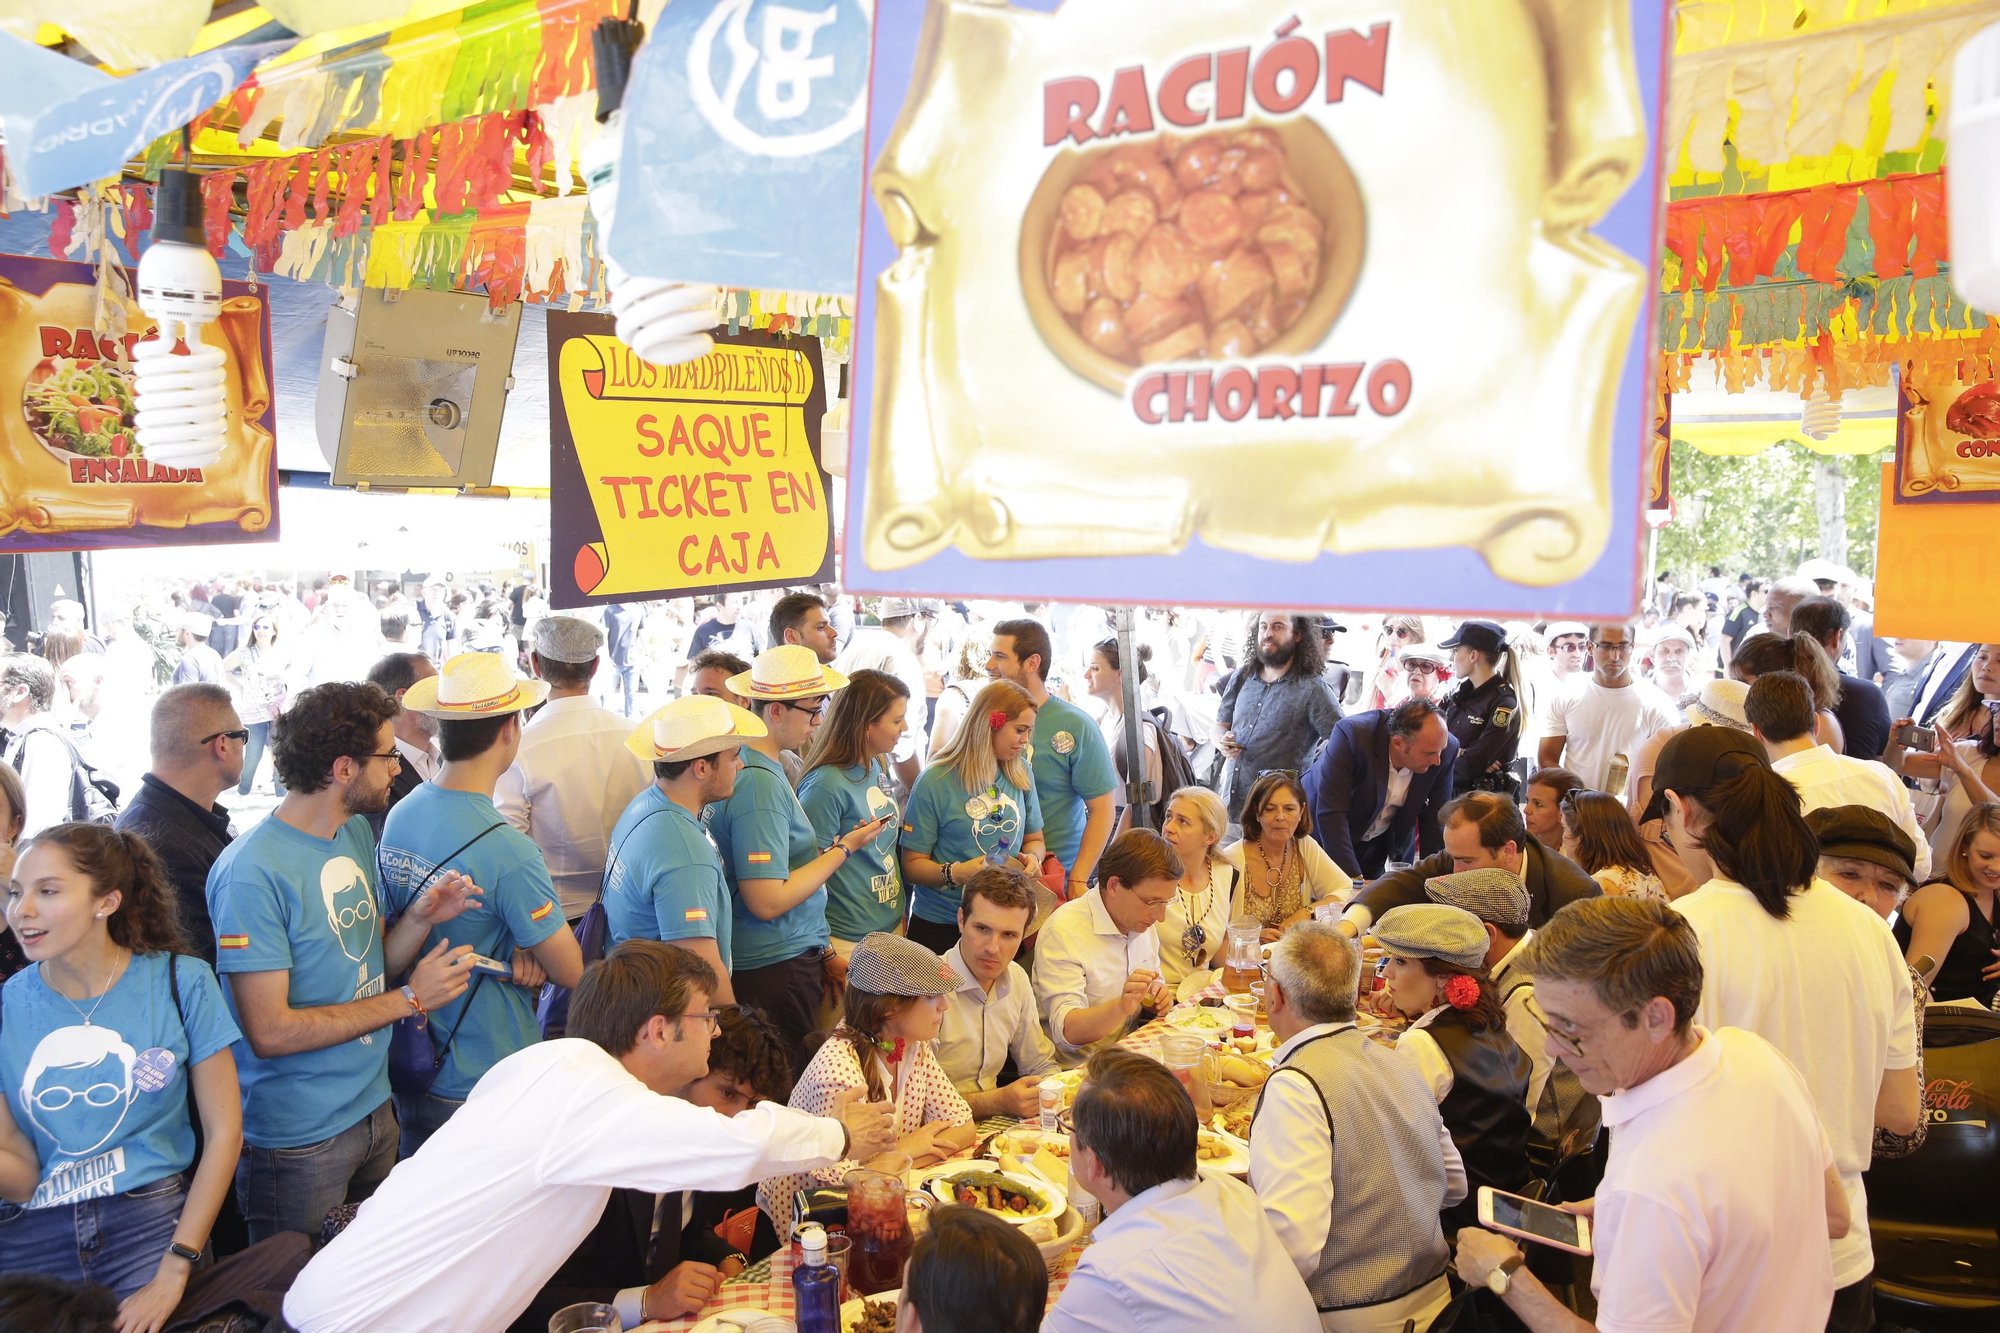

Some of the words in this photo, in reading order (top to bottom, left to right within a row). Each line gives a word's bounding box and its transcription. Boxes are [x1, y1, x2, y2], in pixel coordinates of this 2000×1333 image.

[1044, 14, 1391, 147] RACIÓN
[662, 348, 792, 394] MADRILEÑOS
[1132, 358, 1412, 425] CHORIZO
[636, 413, 775, 467] SAQUE
[600, 472, 752, 519] TICKET
[767, 471, 817, 514] EN
[678, 531, 780, 577] CAJA
[1926, 1109, 1948, 1122] ro
[52, 1151, 118, 1198] ALMEIDA
